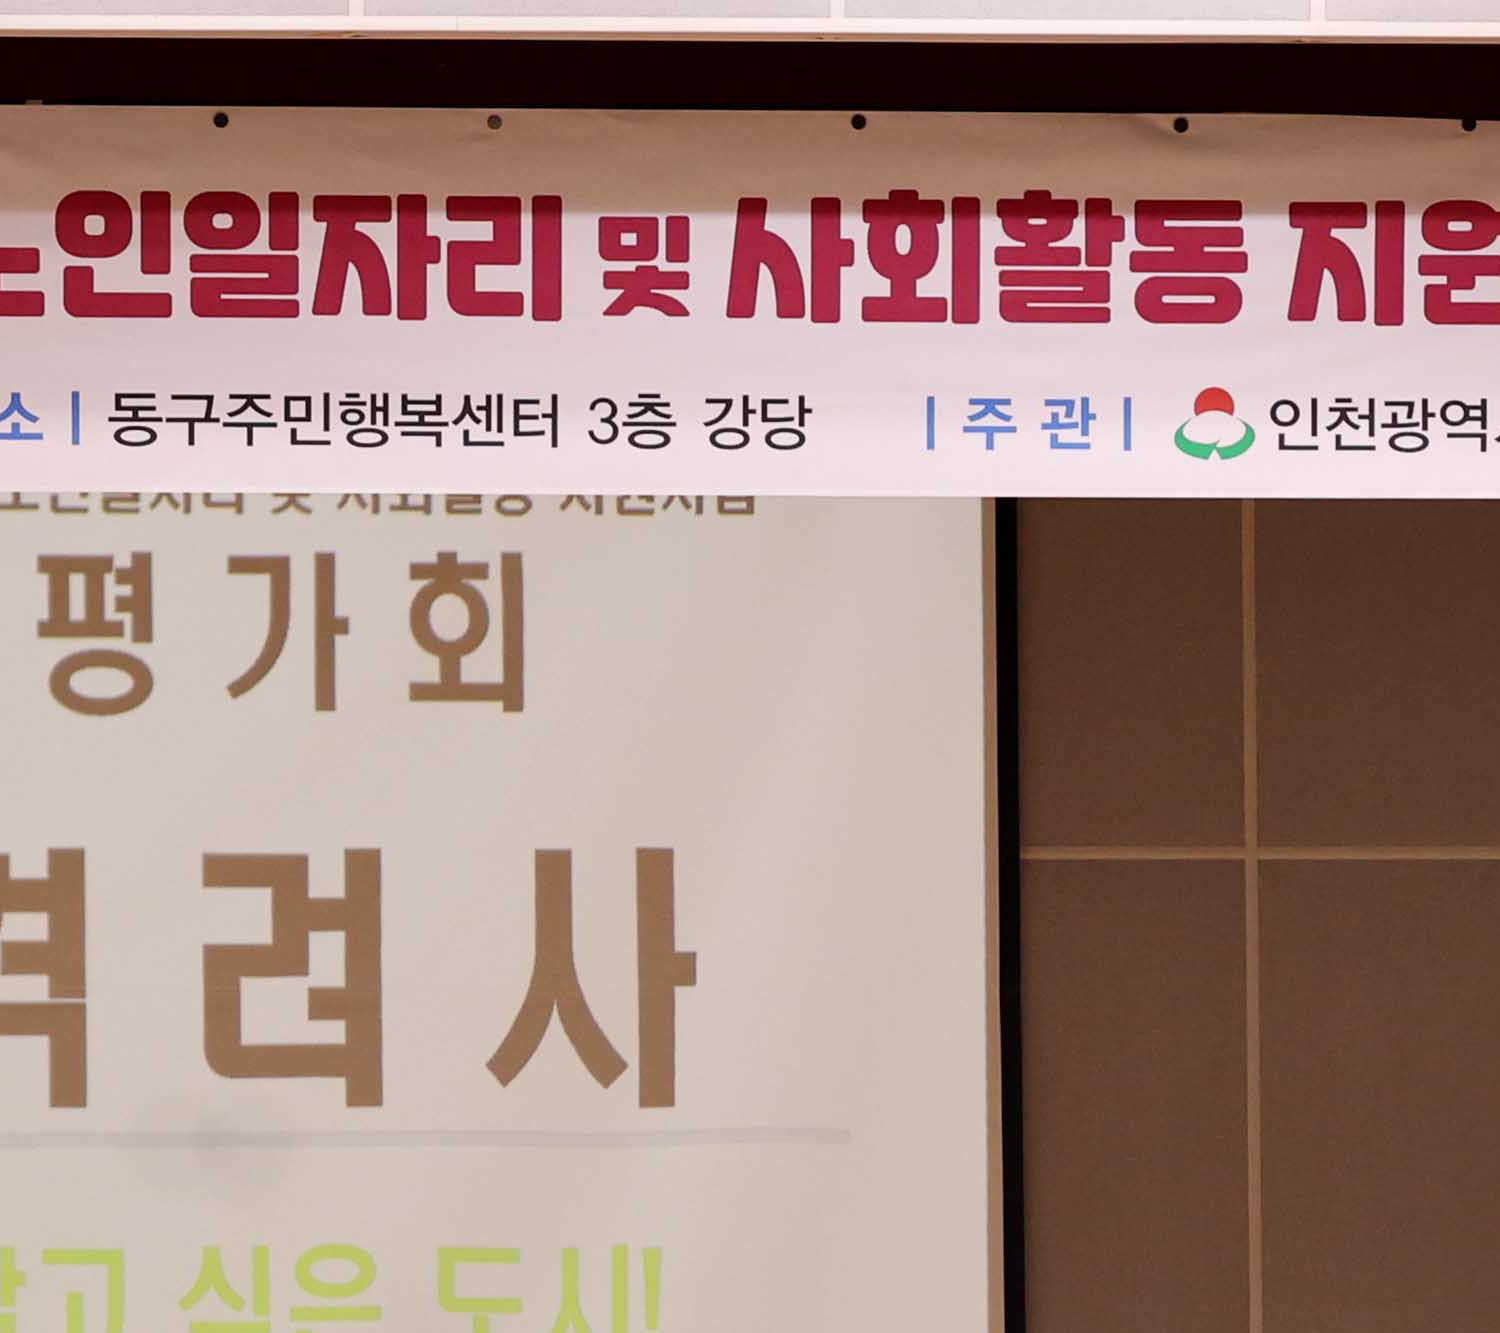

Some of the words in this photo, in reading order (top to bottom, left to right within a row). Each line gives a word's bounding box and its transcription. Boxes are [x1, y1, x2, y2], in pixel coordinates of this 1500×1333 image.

[600, 216, 689, 316] 및
[728, 190, 1247, 323] 사회활동
[108, 392, 558, 448] 동구주민행복센터
[588, 393, 677, 449] 3층
[703, 395, 813, 450] 강당
